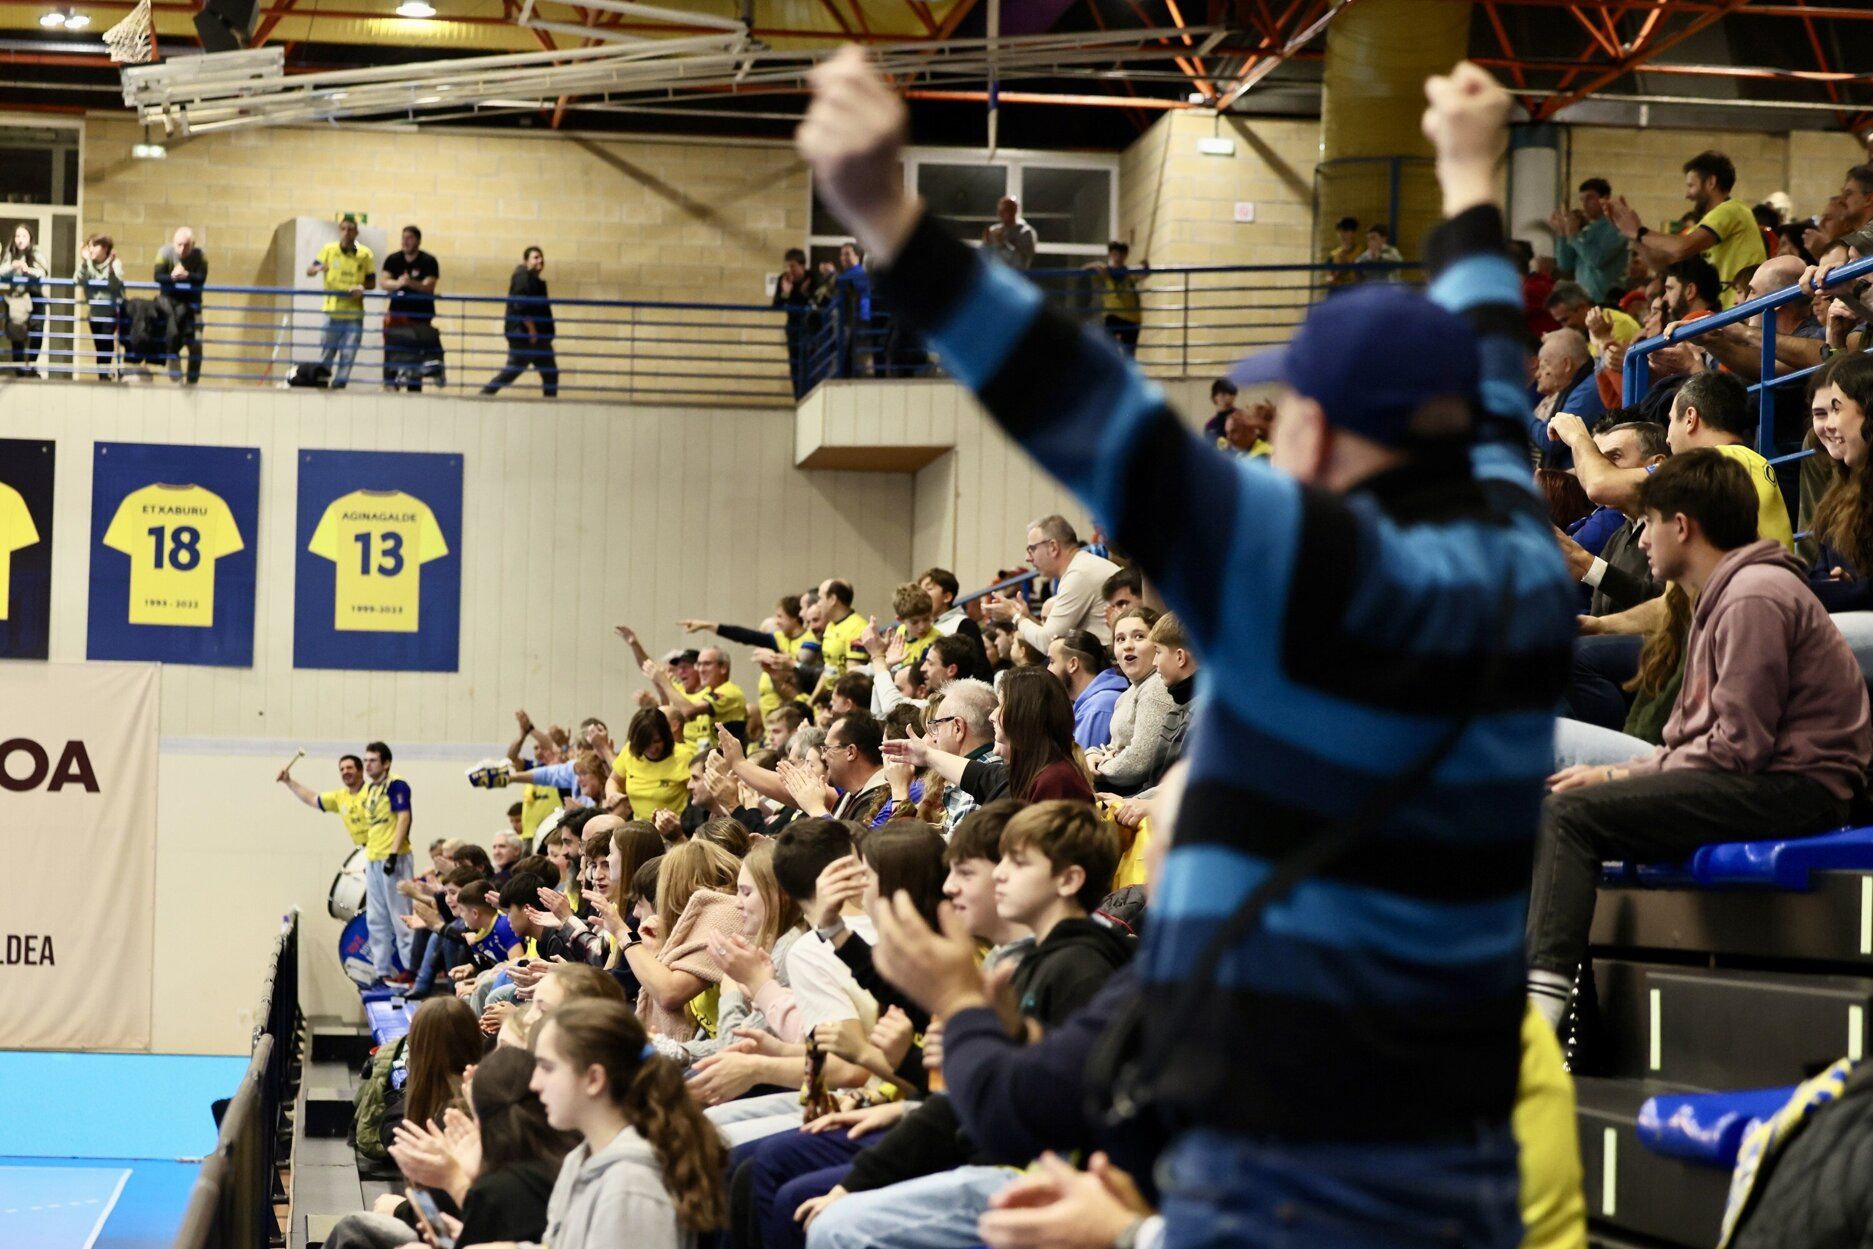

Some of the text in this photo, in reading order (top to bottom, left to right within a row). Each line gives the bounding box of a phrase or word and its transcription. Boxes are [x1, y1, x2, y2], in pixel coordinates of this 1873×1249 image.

[142, 505, 208, 516] ETXABURU
[342, 512, 417, 522] AGINAGALDE
[148, 525, 201, 571] 18
[354, 531, 405, 577] 13
[0, 934, 55, 967] DEA
